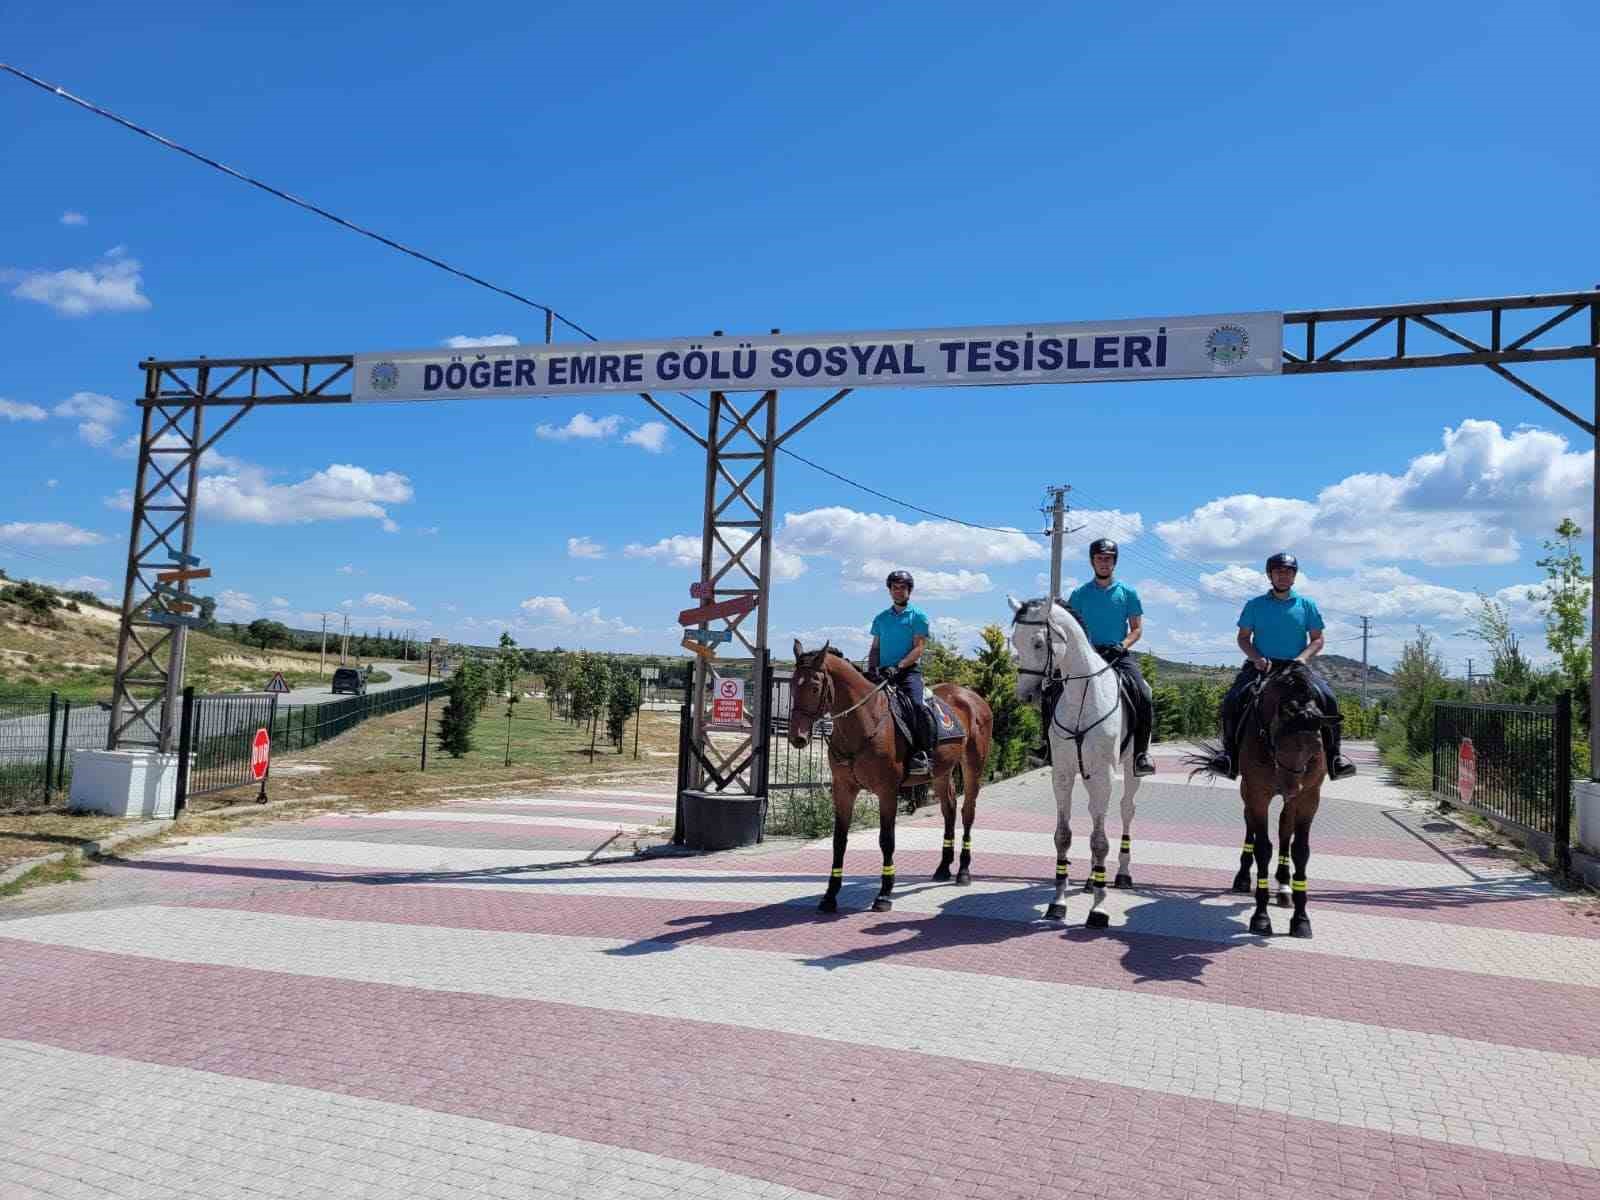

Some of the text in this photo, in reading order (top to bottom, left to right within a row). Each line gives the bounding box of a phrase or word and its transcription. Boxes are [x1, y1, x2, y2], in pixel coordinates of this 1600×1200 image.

[423, 354, 537, 392] DÖĞER
[547, 354, 644, 387] EMRE
[655, 344, 757, 381] GÖLÜ
[770, 343, 926, 380] SOSYAL
[939, 327, 1169, 374] TESİSLERİ
[252, 743, 269, 764] DUR
